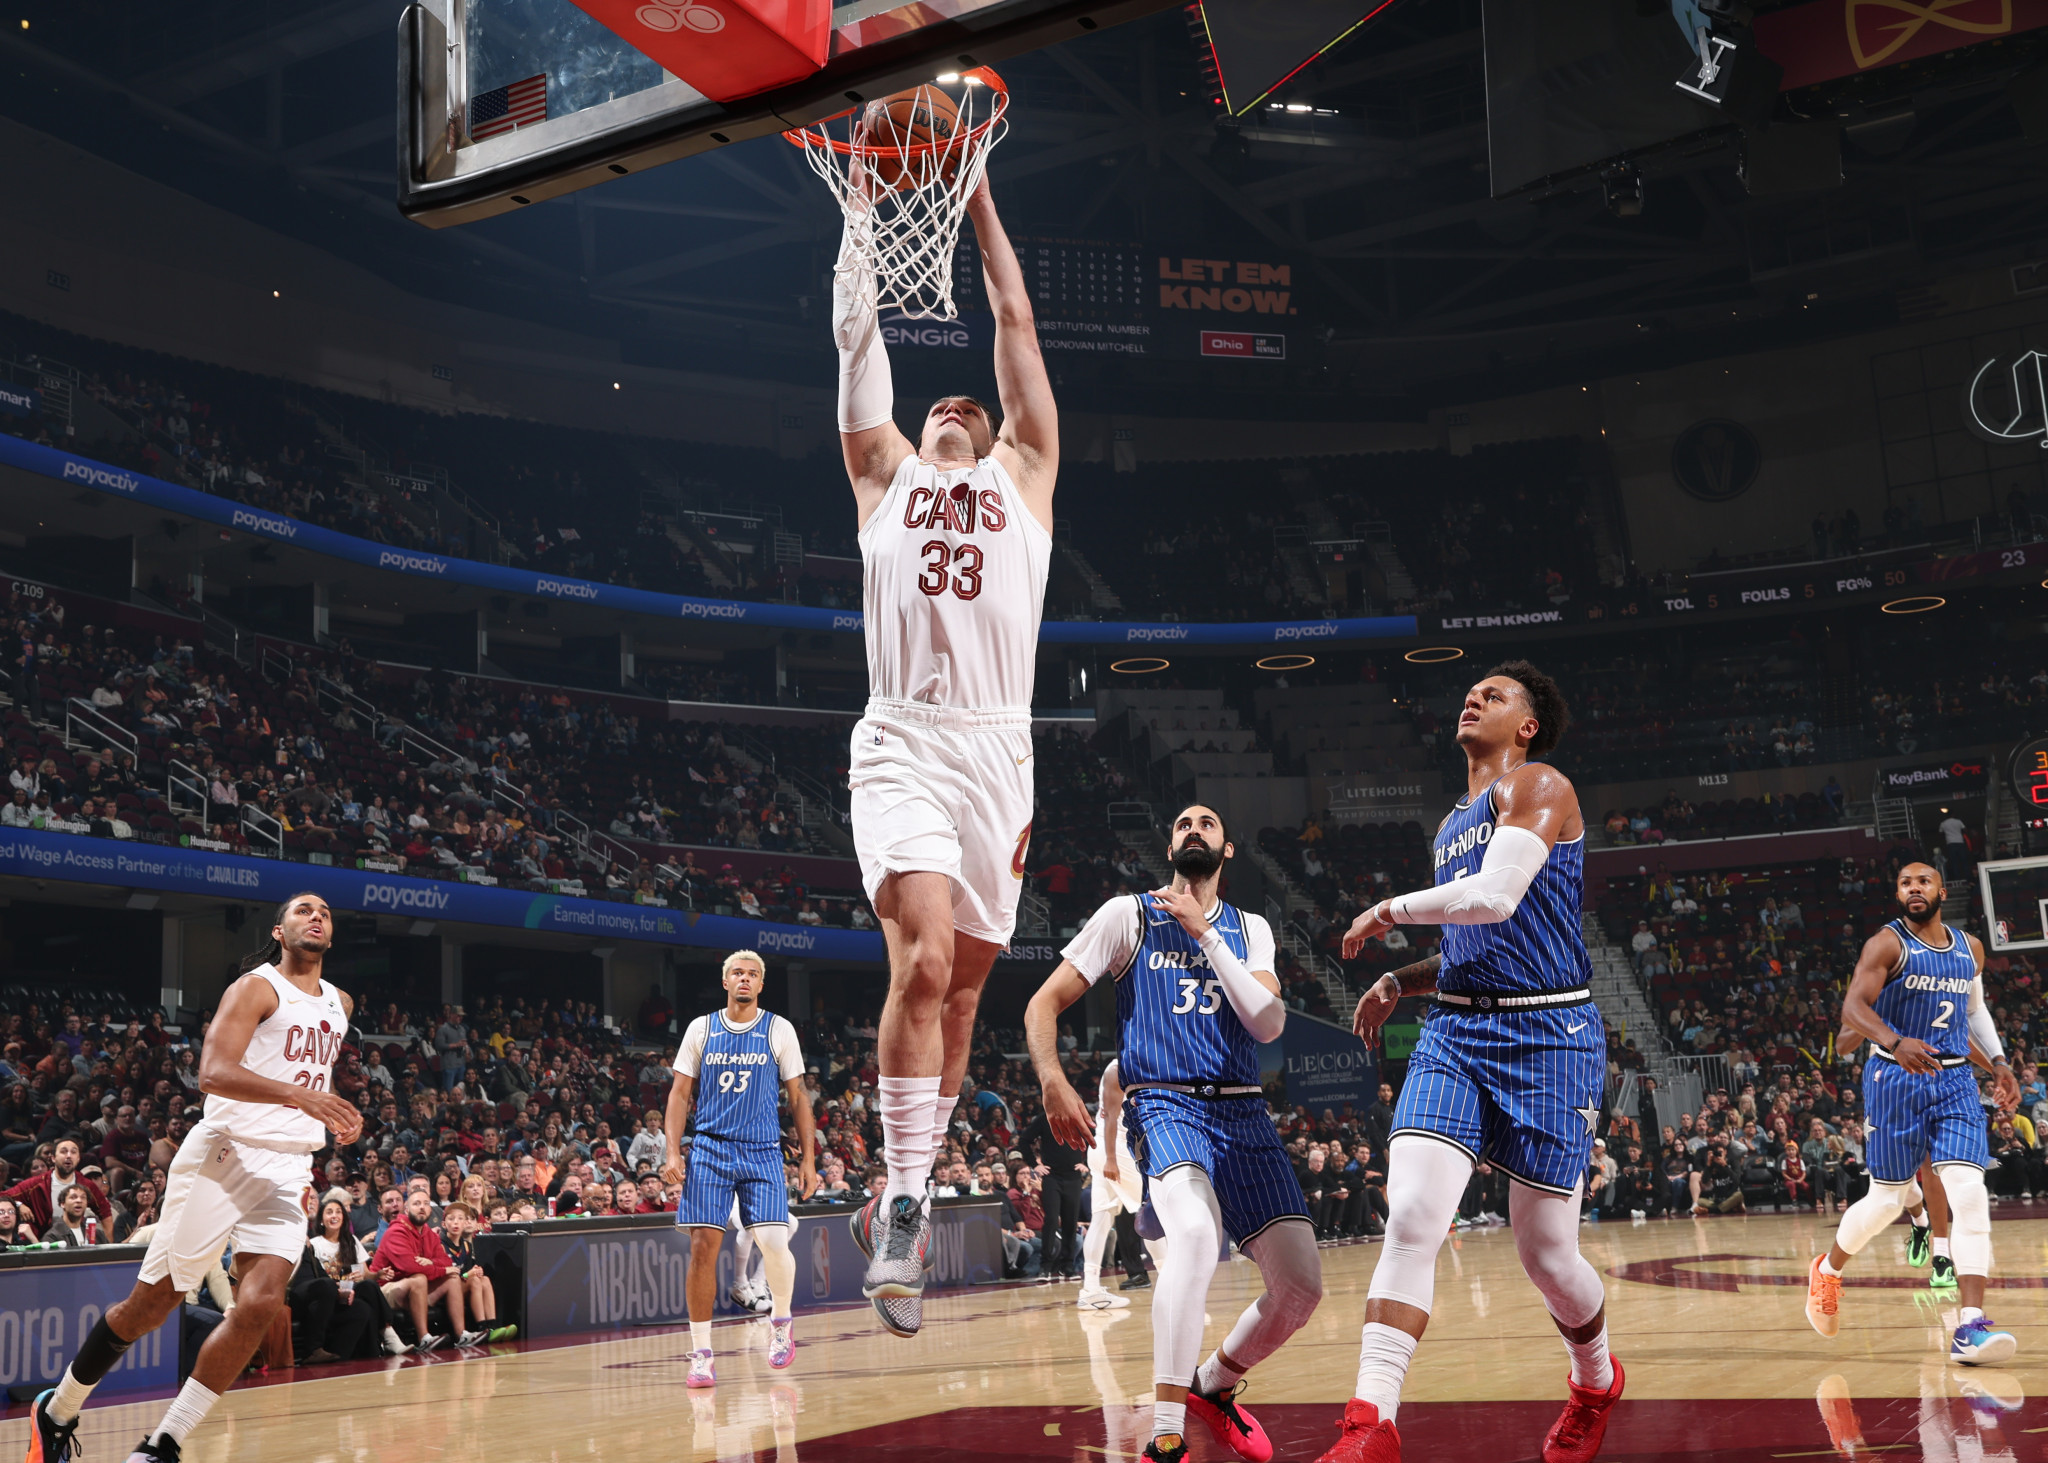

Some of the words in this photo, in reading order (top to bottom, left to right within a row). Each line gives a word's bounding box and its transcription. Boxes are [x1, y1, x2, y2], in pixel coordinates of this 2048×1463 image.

[1159, 257, 1231, 282] LET
[1237, 262, 1291, 286] EM
[1160, 285, 1297, 315] KNOW.
[1035, 321, 1102, 332] UBSTITUTION
[1107, 325, 1150, 335] NUMBER
[1045, 340, 1095, 350] DONOVAN
[1097, 342, 1145, 353] MITCHELL
[1212, 338, 1243, 350] Ohio
[0, 390, 32, 409] mart
[64, 460, 138, 493] payactiv
[411, 481, 427, 492] 213
[903, 483, 1006, 534] CAVS
[232, 510, 296, 539] payactiv
[380, 551, 447, 574] payactiv
[2001, 551, 2025, 567] 23
[918, 540, 984, 600] 33
[536, 579, 598, 599] payactiv
[1836, 577, 1872, 592] FG%
[1884, 570, 1905, 586] 50
[22, 583, 44, 599] 109
[1741, 588, 1791, 603] FOULS
[1804, 584, 1815, 598] 5
[682, 602, 746, 619] payactiv
[1620, 603, 1638, 615] +6
[1664, 598, 1695, 611] TOL
[1708, 594, 1718, 608] 5
[1442, 617, 1474, 629] LET
[1476, 616, 1501, 627] EM
[1503, 611, 1563, 626] KNOW.
[1128, 625, 1188, 641] payactiv
[1275, 623, 1338, 640] payactiv
[1698, 773, 1728, 786] M113
[1889, 768, 1949, 785] KeyBank
[1347, 785, 1422, 798] LITEHOUSE
[1396, 809, 1423, 817] CLUB
[190, 836, 230, 851] Huntington
[18, 844, 61, 866] Wage
[63, 850, 114, 870] Access
[117, 855, 166, 875] Partner
[168, 862, 182, 874] of
[184, 864, 204, 879] the
[206, 865, 260, 887] CAVALIERS
[364, 859, 399, 873] Huntington
[363, 883, 449, 909] payactiv
[554, 904, 596, 925] Earned
[597, 911, 638, 933] money,
[640, 914, 656, 931] for
[657, 917, 677, 934] life.
[758, 931, 815, 950] payactiv
[1171, 977, 1223, 1015] 35
[1931, 1000, 1954, 1028] 2
[718, 1070, 752, 1093] 93
